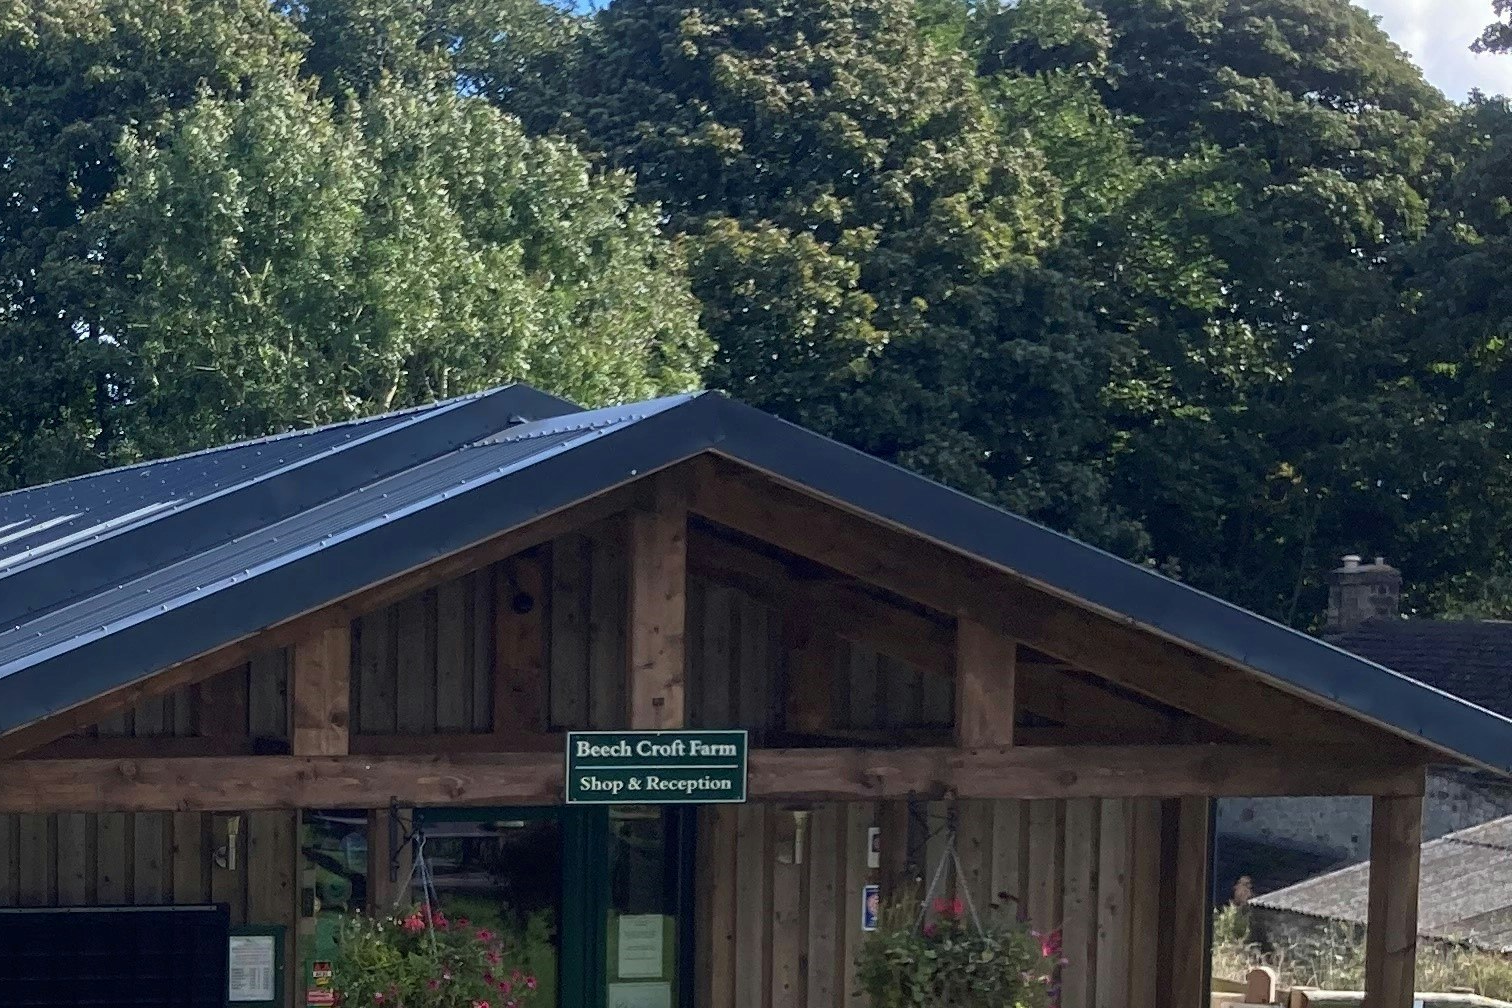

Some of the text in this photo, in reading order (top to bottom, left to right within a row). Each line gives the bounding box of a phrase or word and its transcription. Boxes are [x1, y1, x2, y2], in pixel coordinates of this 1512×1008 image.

[576, 739, 737, 757] Beech Croft Farm
[580, 775, 731, 795] Shop & Reception
